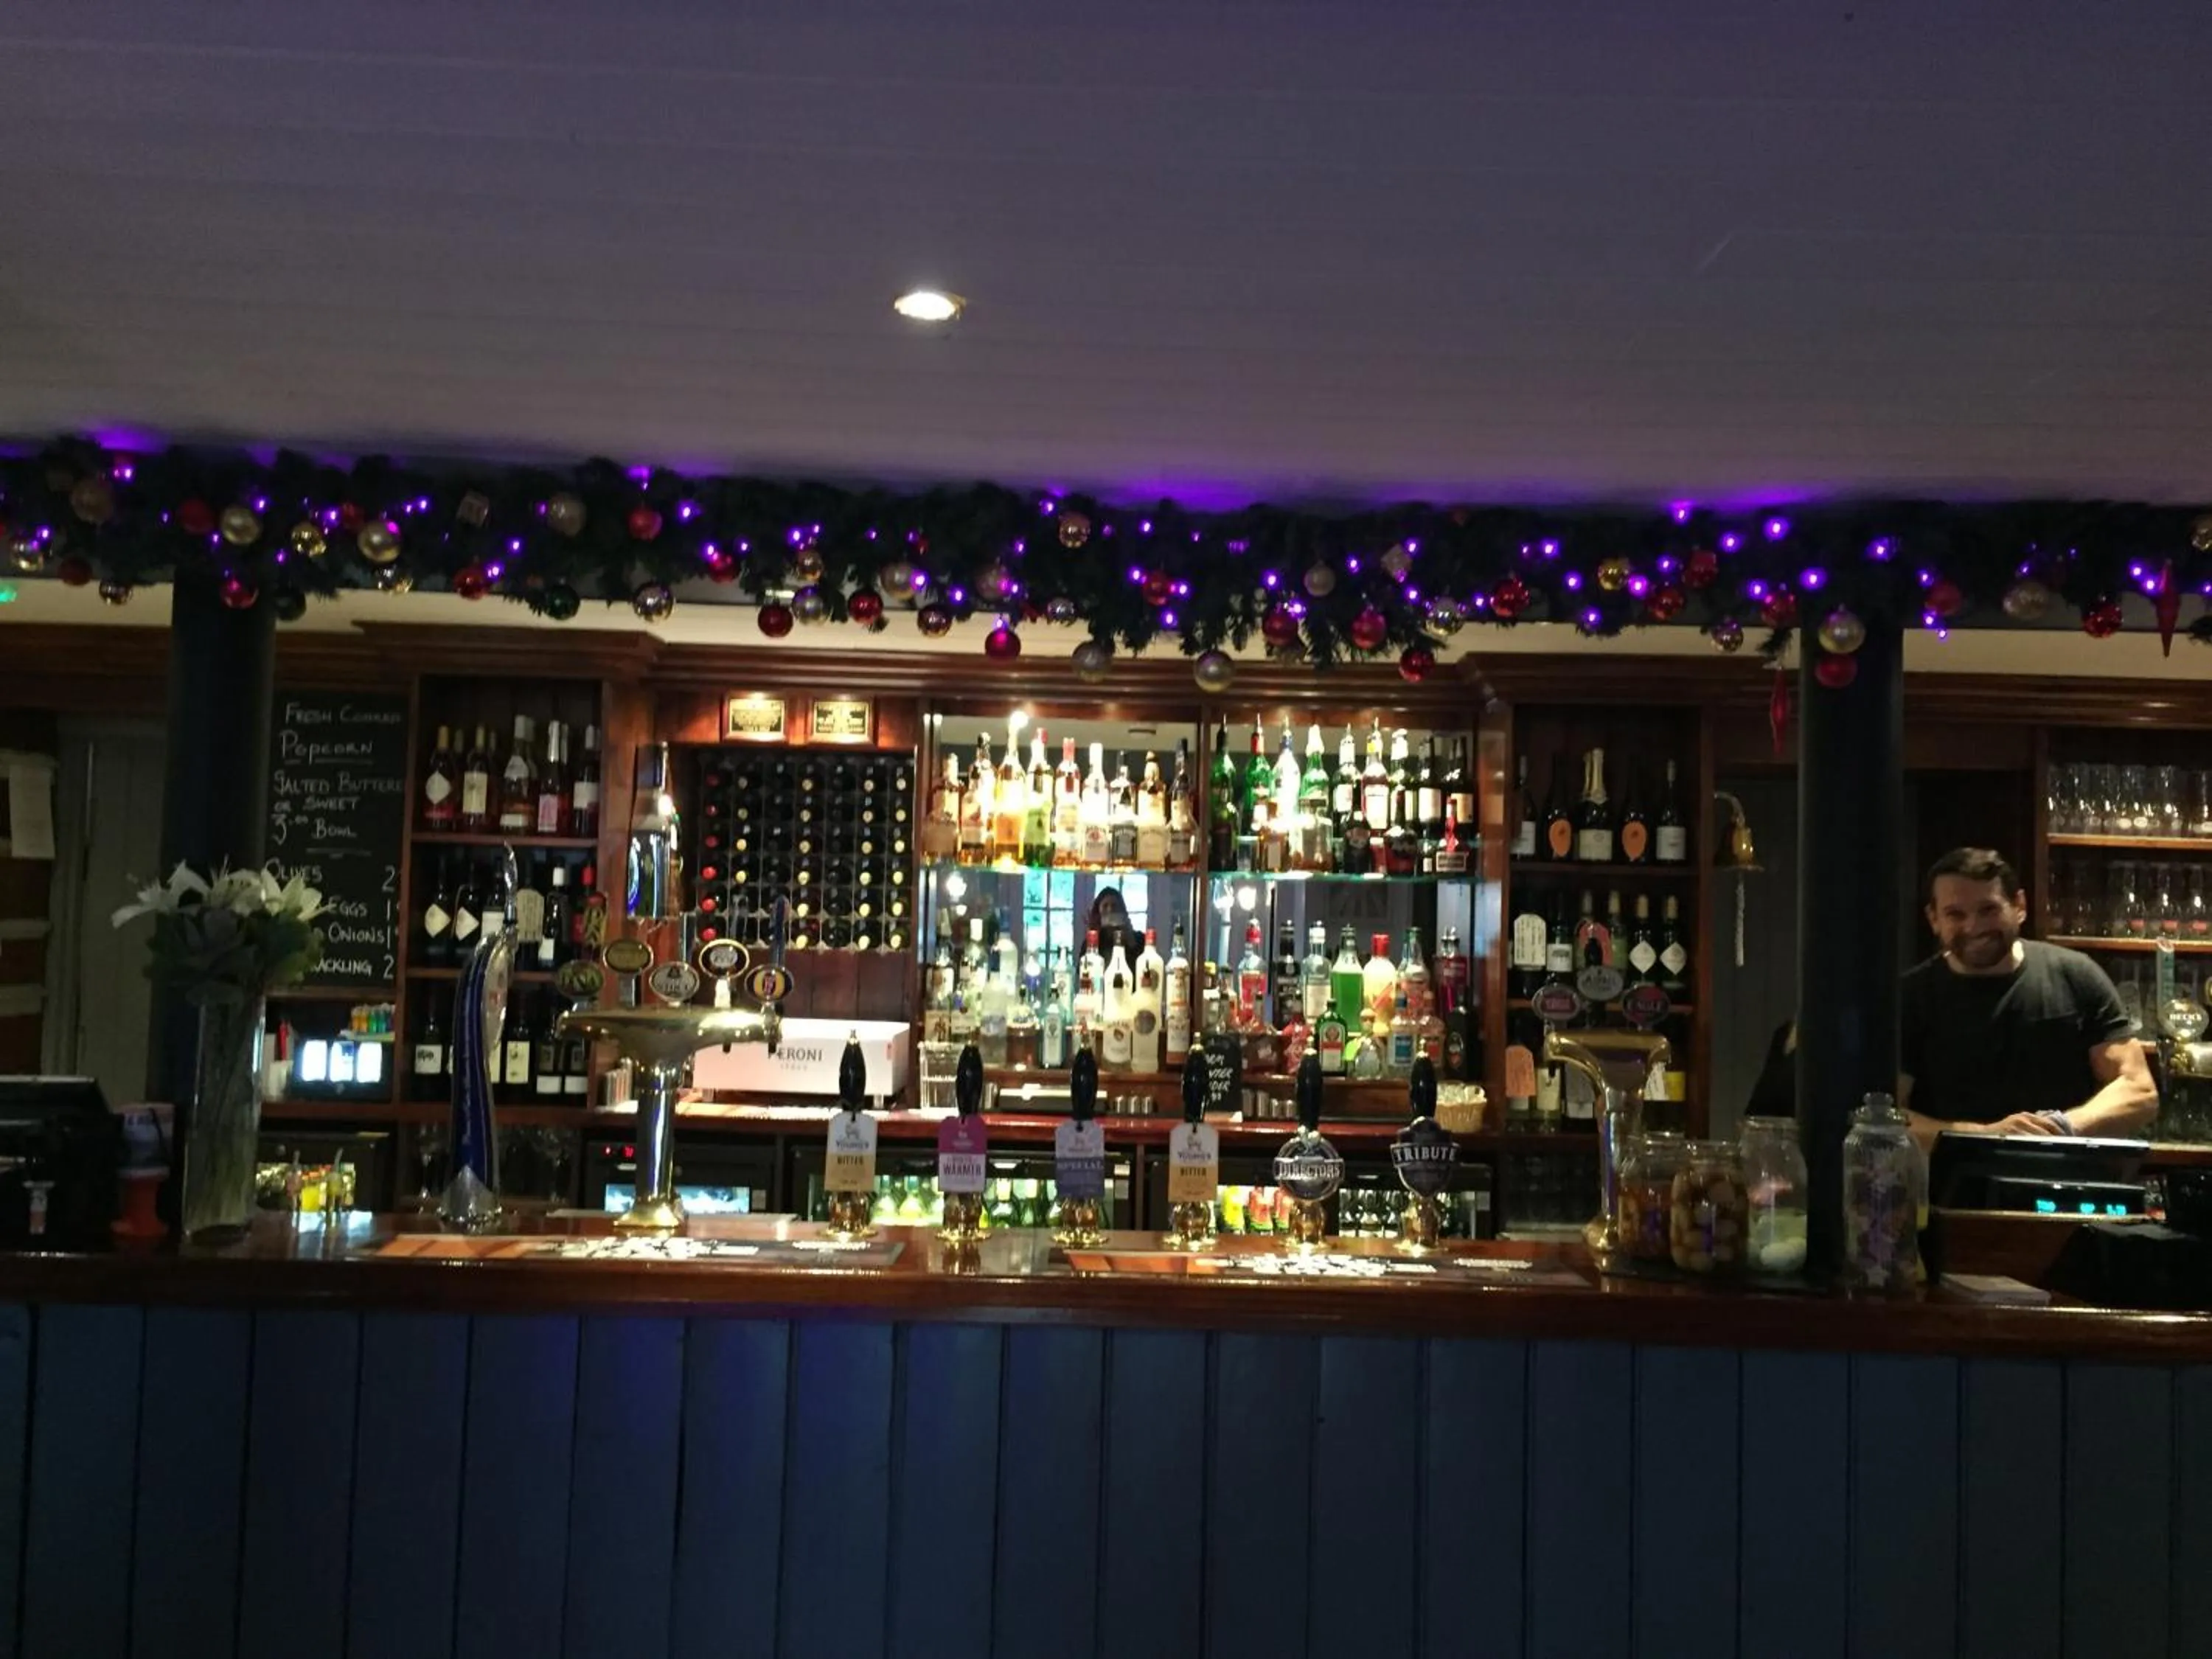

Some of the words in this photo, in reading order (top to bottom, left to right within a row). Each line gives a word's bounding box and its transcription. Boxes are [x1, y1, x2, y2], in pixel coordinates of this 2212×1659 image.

[274, 770, 330, 796] SALTED
[302, 795, 361, 811] SWEET
[328, 895, 368, 917] EGGS
[328, 922, 385, 944] ONIONS
[837, 1155, 864, 1166] BITTER
[1393, 1145, 1457, 1163] TRIBUTE
[942, 1162, 982, 1177] WARMER
[1179, 1166, 1207, 1178] BITTER
